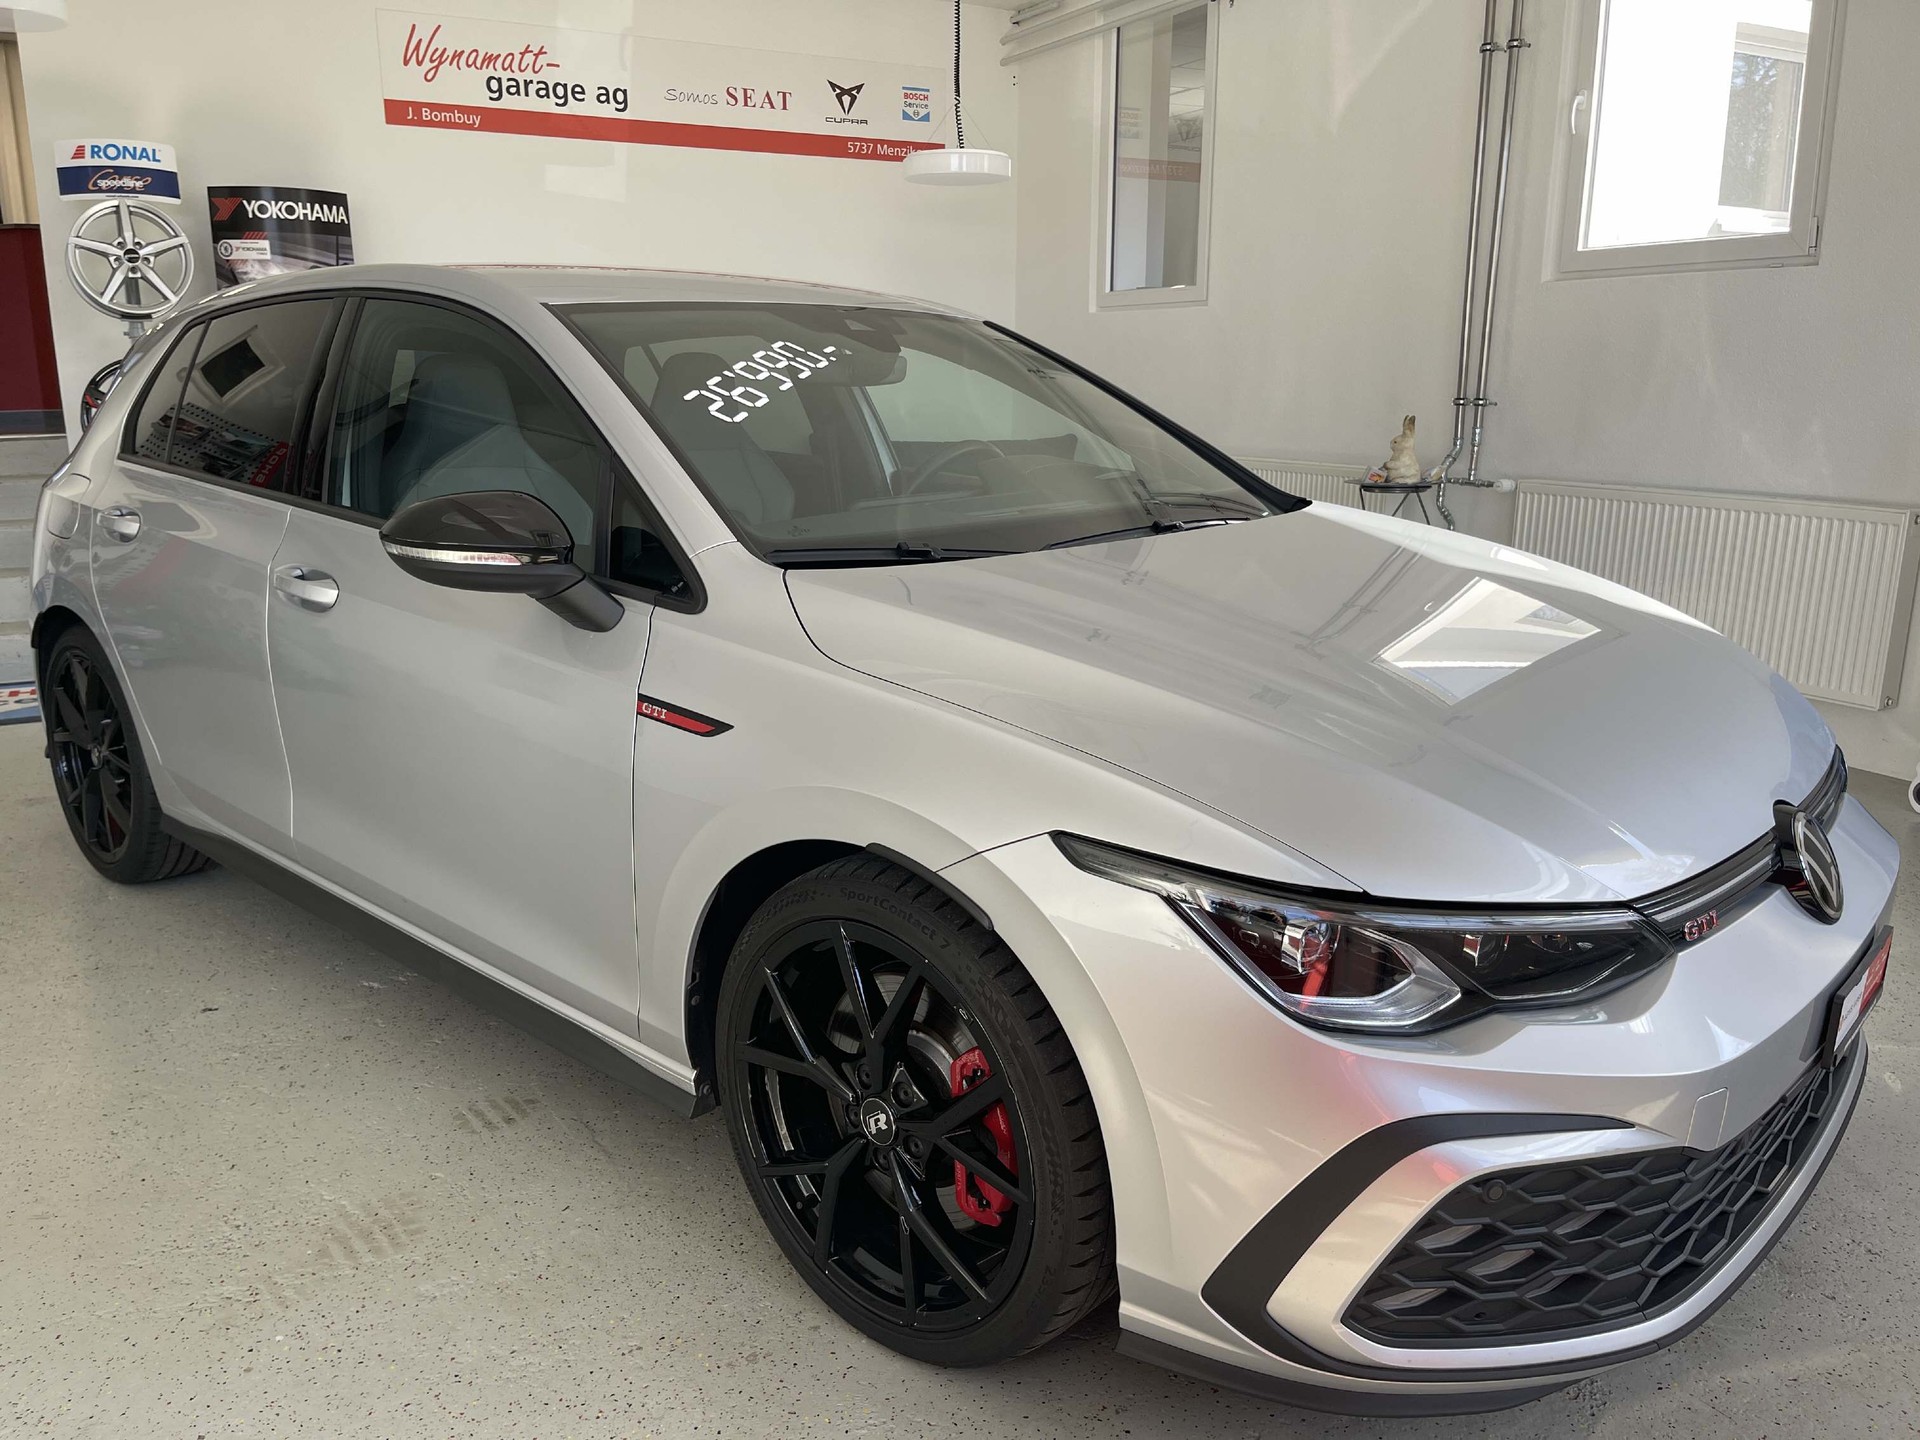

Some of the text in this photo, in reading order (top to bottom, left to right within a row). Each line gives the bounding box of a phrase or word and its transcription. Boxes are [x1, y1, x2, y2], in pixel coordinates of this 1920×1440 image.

[402, 23, 561, 83] Wynamatt-
[485, 74, 629, 113] garage ag
[663, 86, 793, 111] Somos SEAT
[903, 92, 929, 102] BOSCH
[903, 101, 929, 110] Service
[406, 106, 481, 128] J. Bombuy
[825, 116, 869, 126] CUPRA
[90, 143, 161, 163] RONAL
[847, 141, 922, 157] 5737 Menzik
[242, 199, 349, 225] YOKOHAMA
[641, 702, 668, 719] GTI
[839, 887, 938, 941] SportContact
[1683, 910, 1719, 942] GTI
